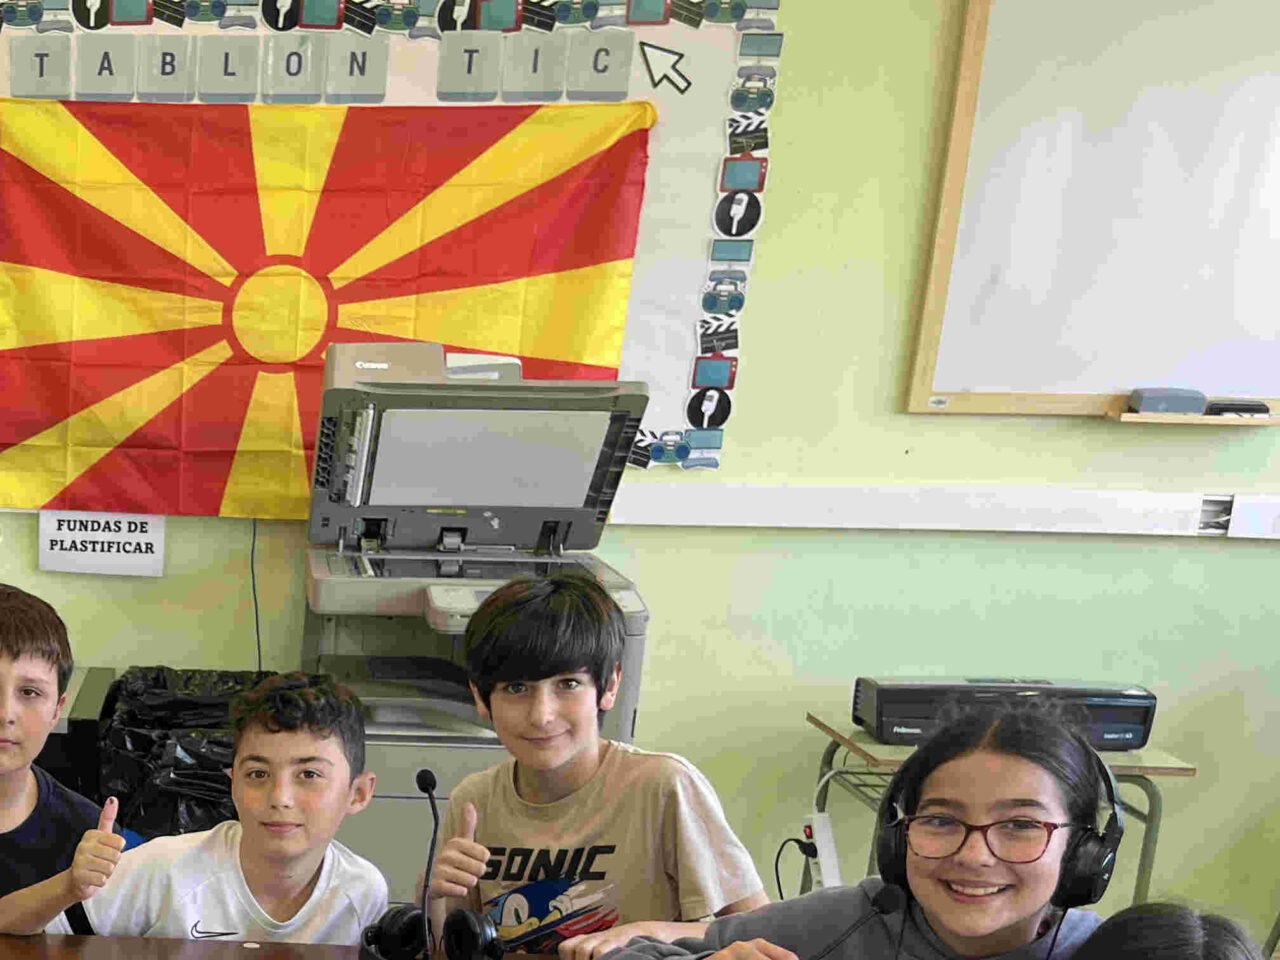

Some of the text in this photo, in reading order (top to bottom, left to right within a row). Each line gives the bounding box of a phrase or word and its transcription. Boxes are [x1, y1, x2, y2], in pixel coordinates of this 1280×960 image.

[34, 48, 610, 78] TABLON TIC
[56, 519, 149, 534] FUNDAS DE
[49, 539, 155, 554] PLASTIFICAR
[481, 845, 616, 881] SONIC
